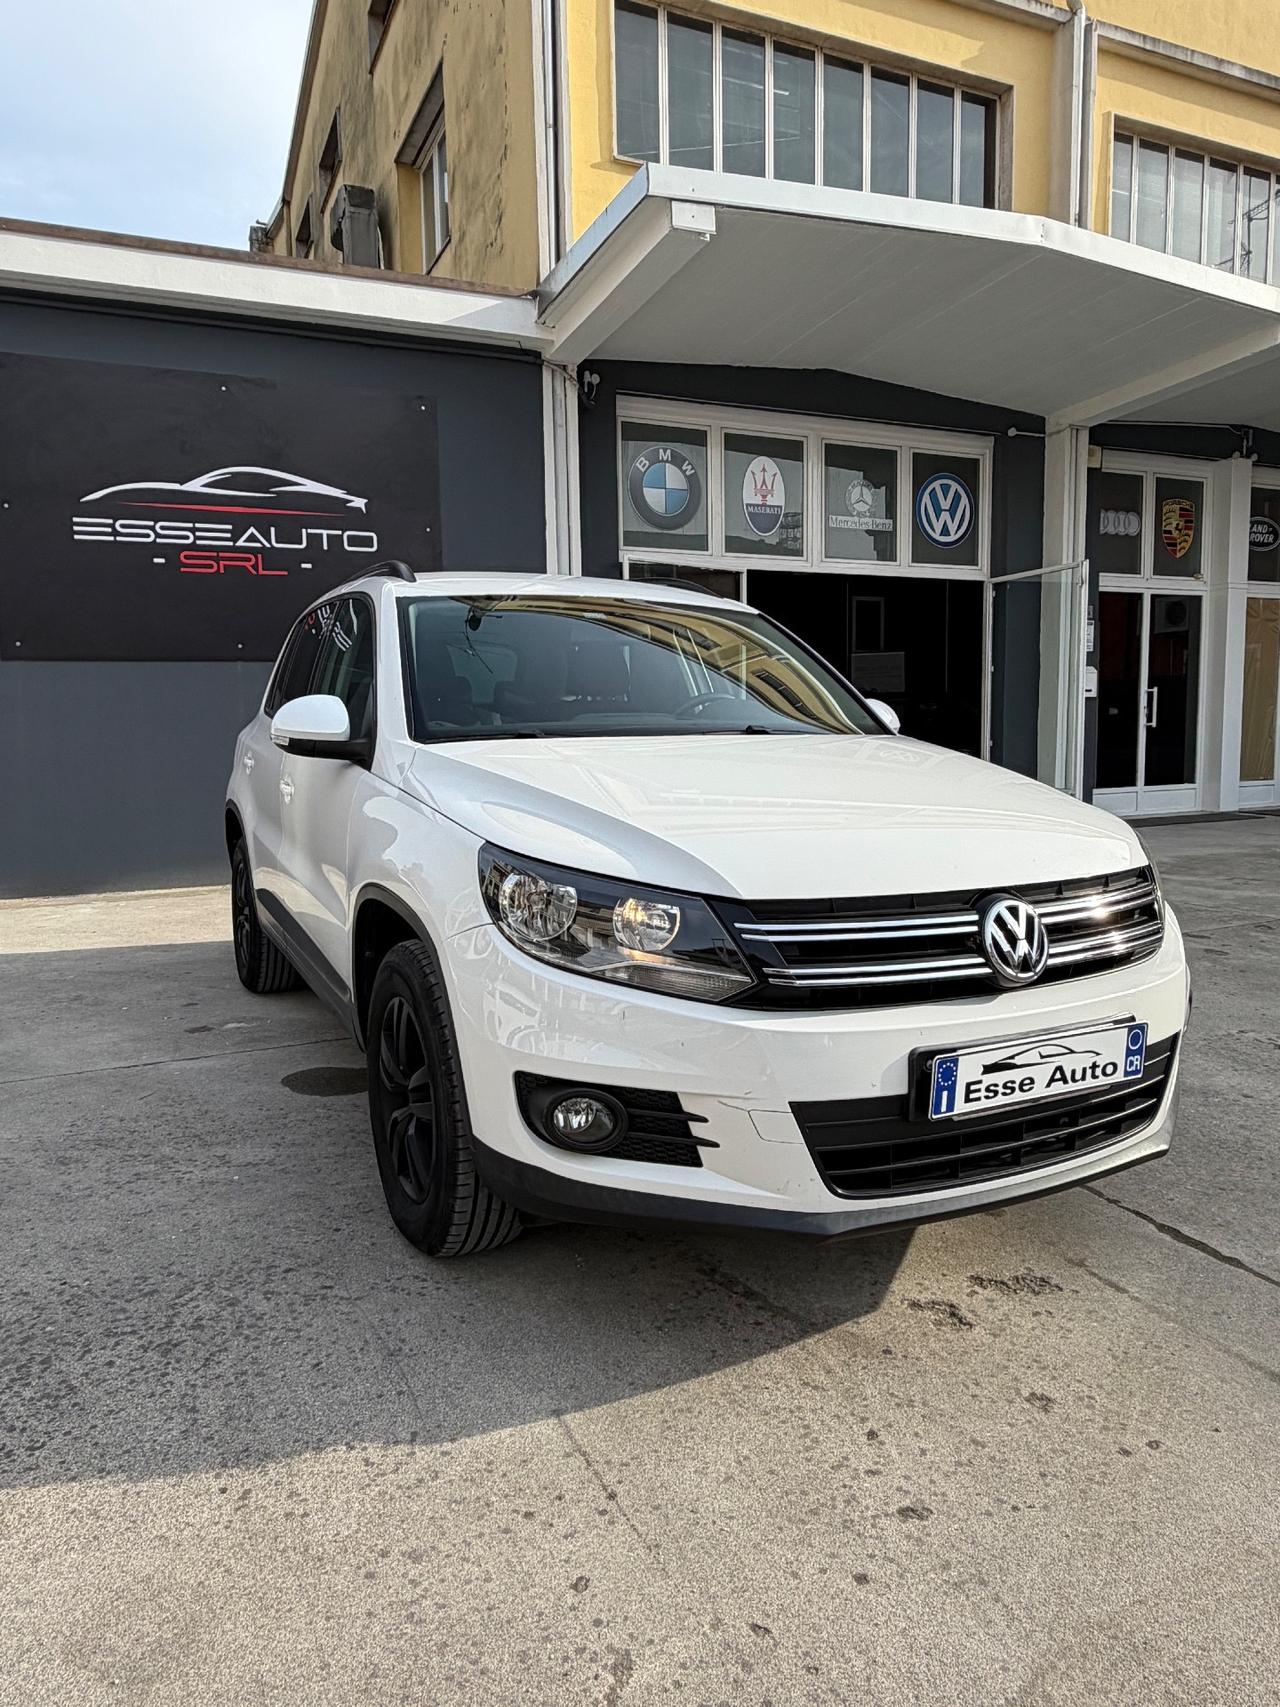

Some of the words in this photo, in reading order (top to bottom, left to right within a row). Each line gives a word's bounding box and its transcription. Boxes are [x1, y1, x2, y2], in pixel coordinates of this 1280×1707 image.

[635, 448, 696, 477] BMW
[747, 505, 781, 515] MASERATI
[72, 516, 378, 552] ESSEAUTO
[1249, 533, 1275, 543] ROVER
[179, 551, 289, 576] SRL
[1126, 1054, 1141, 1072] CR
[963, 1075, 1036, 1104] Esse
[1044, 1060, 1119, 1089] Auto
